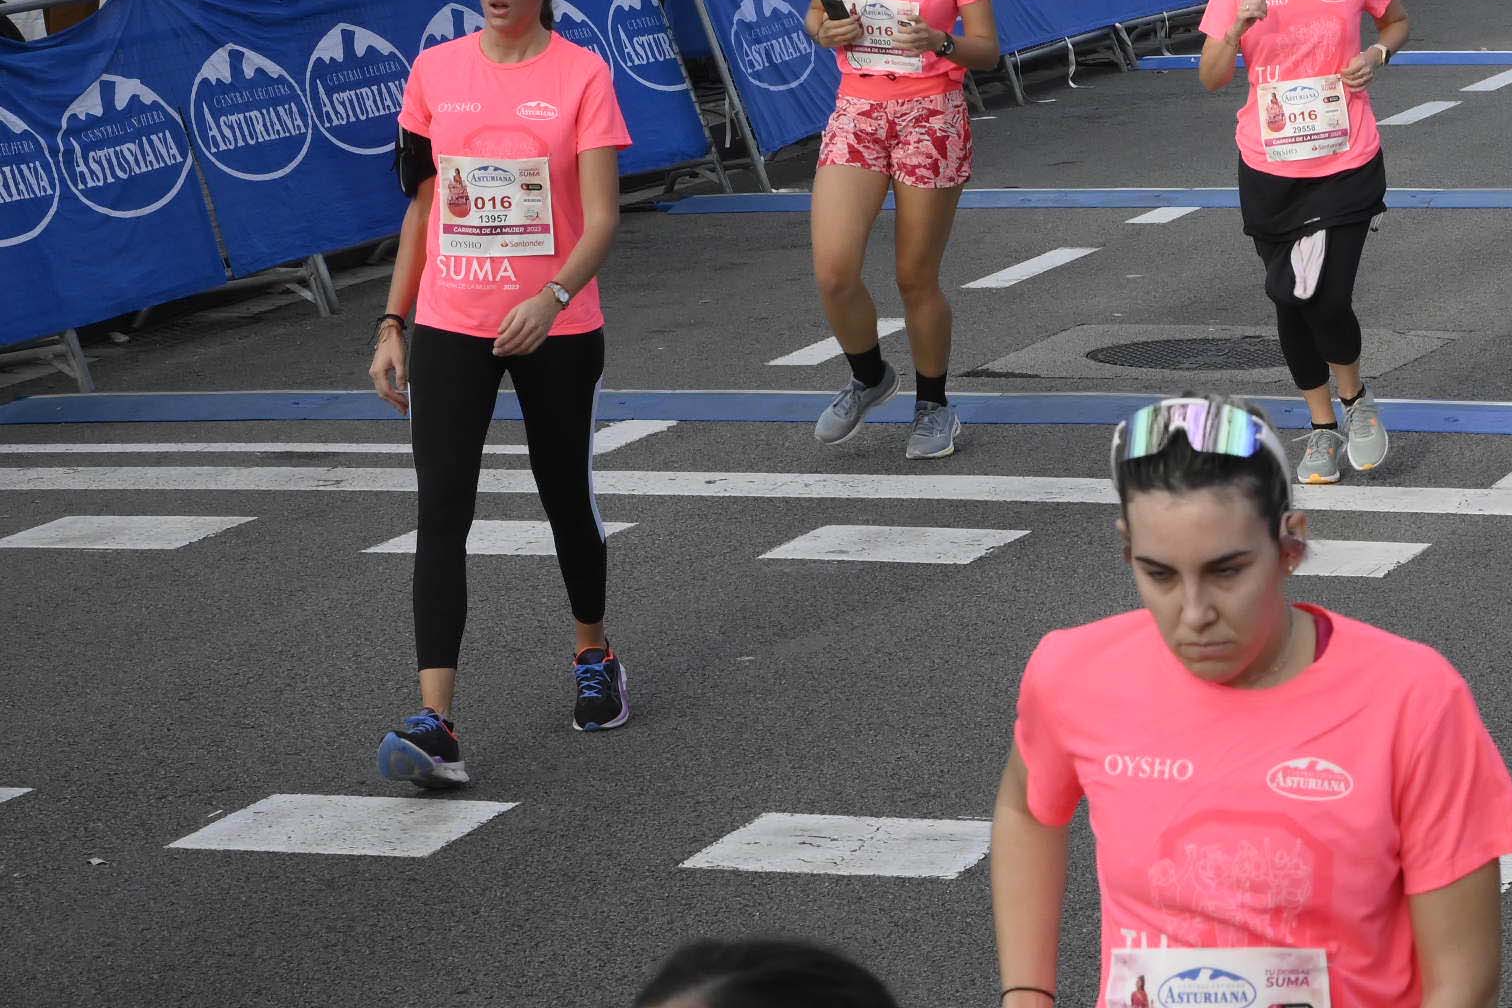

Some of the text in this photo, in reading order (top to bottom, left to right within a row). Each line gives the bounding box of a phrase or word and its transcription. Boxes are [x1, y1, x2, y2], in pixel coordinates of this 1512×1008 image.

[866, 25, 894, 37] 016
[326, 60, 401, 86] CENTRAL LECHERA
[1255, 65, 1281, 84] TU
[213, 83, 291, 109] CENTRAL LECHERA
[437, 102, 482, 113] OYSHO
[1288, 109, 1318, 123] 016
[81, 123, 125, 144] CENTRAL
[203, 100, 306, 154] ASTURIANA
[69, 129, 184, 191] ASTURIANA
[471, 173, 513, 183] ASTURIANA
[473, 195, 513, 210] 016
[478, 214, 509, 224] 13957
[453, 226, 481, 234] CARRERA
[450, 239, 545, 250] OYSHO Santander
[436, 255, 517, 282] SUMA
[1104, 754, 1194, 781] OYSHO
[1273, 769, 1346, 793] ASTURIANA
[1265, 976, 1310, 988] SUMA
[1163, 985, 1249, 1005] ASTURIANA
